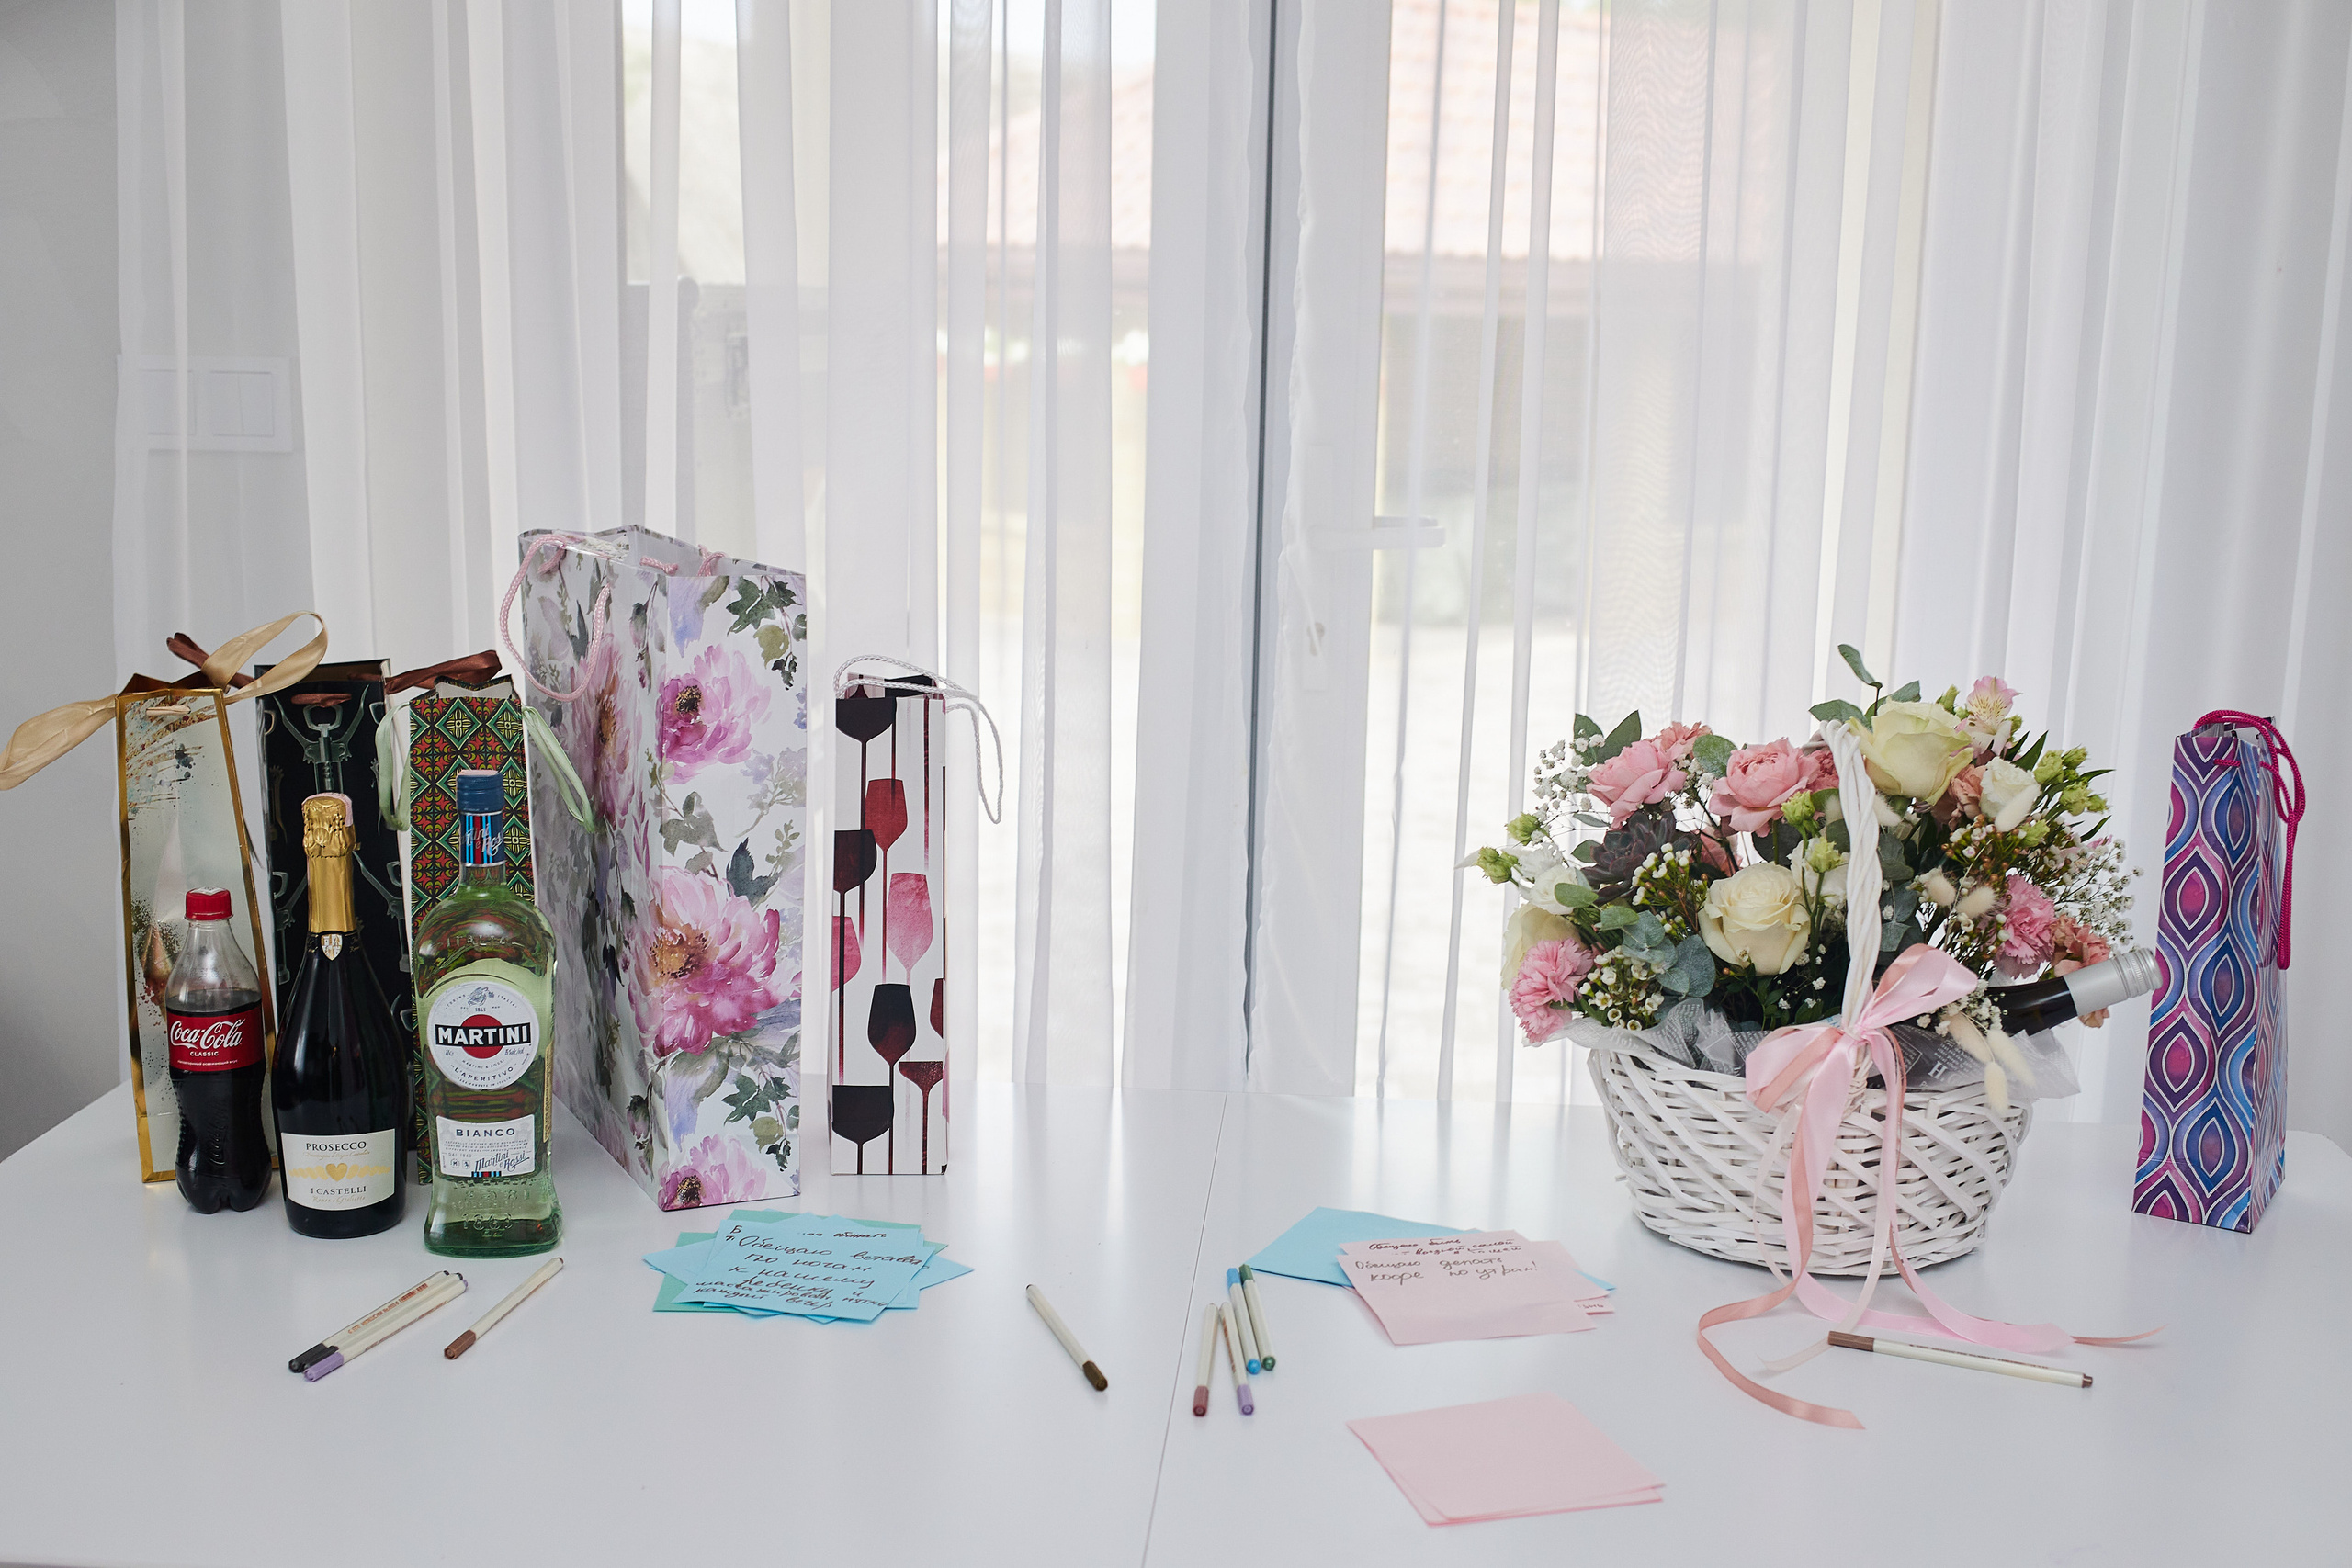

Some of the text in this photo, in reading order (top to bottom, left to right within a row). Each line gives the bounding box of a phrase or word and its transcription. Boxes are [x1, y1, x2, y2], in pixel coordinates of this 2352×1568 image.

[171, 1019, 245, 1049] Coca-Cola
[437, 1025, 527, 1045] MARTINI
[454, 1066, 514, 1082] L'APERITIVO
[456, 1128, 515, 1137] BIANCO
[306, 1141, 367, 1151] PROSECCO
[475, 1150, 509, 1173] Martini
[316, 1186, 367, 1195] CASTELLI
[739, 1235, 832, 1256] Обещаю
[744, 1253, 872, 1271] по ночам
[1355, 1260, 1421, 1269] Обещаю
[758, 1269, 875, 1289] нашему
[1370, 1271, 1424, 1286] кофе
